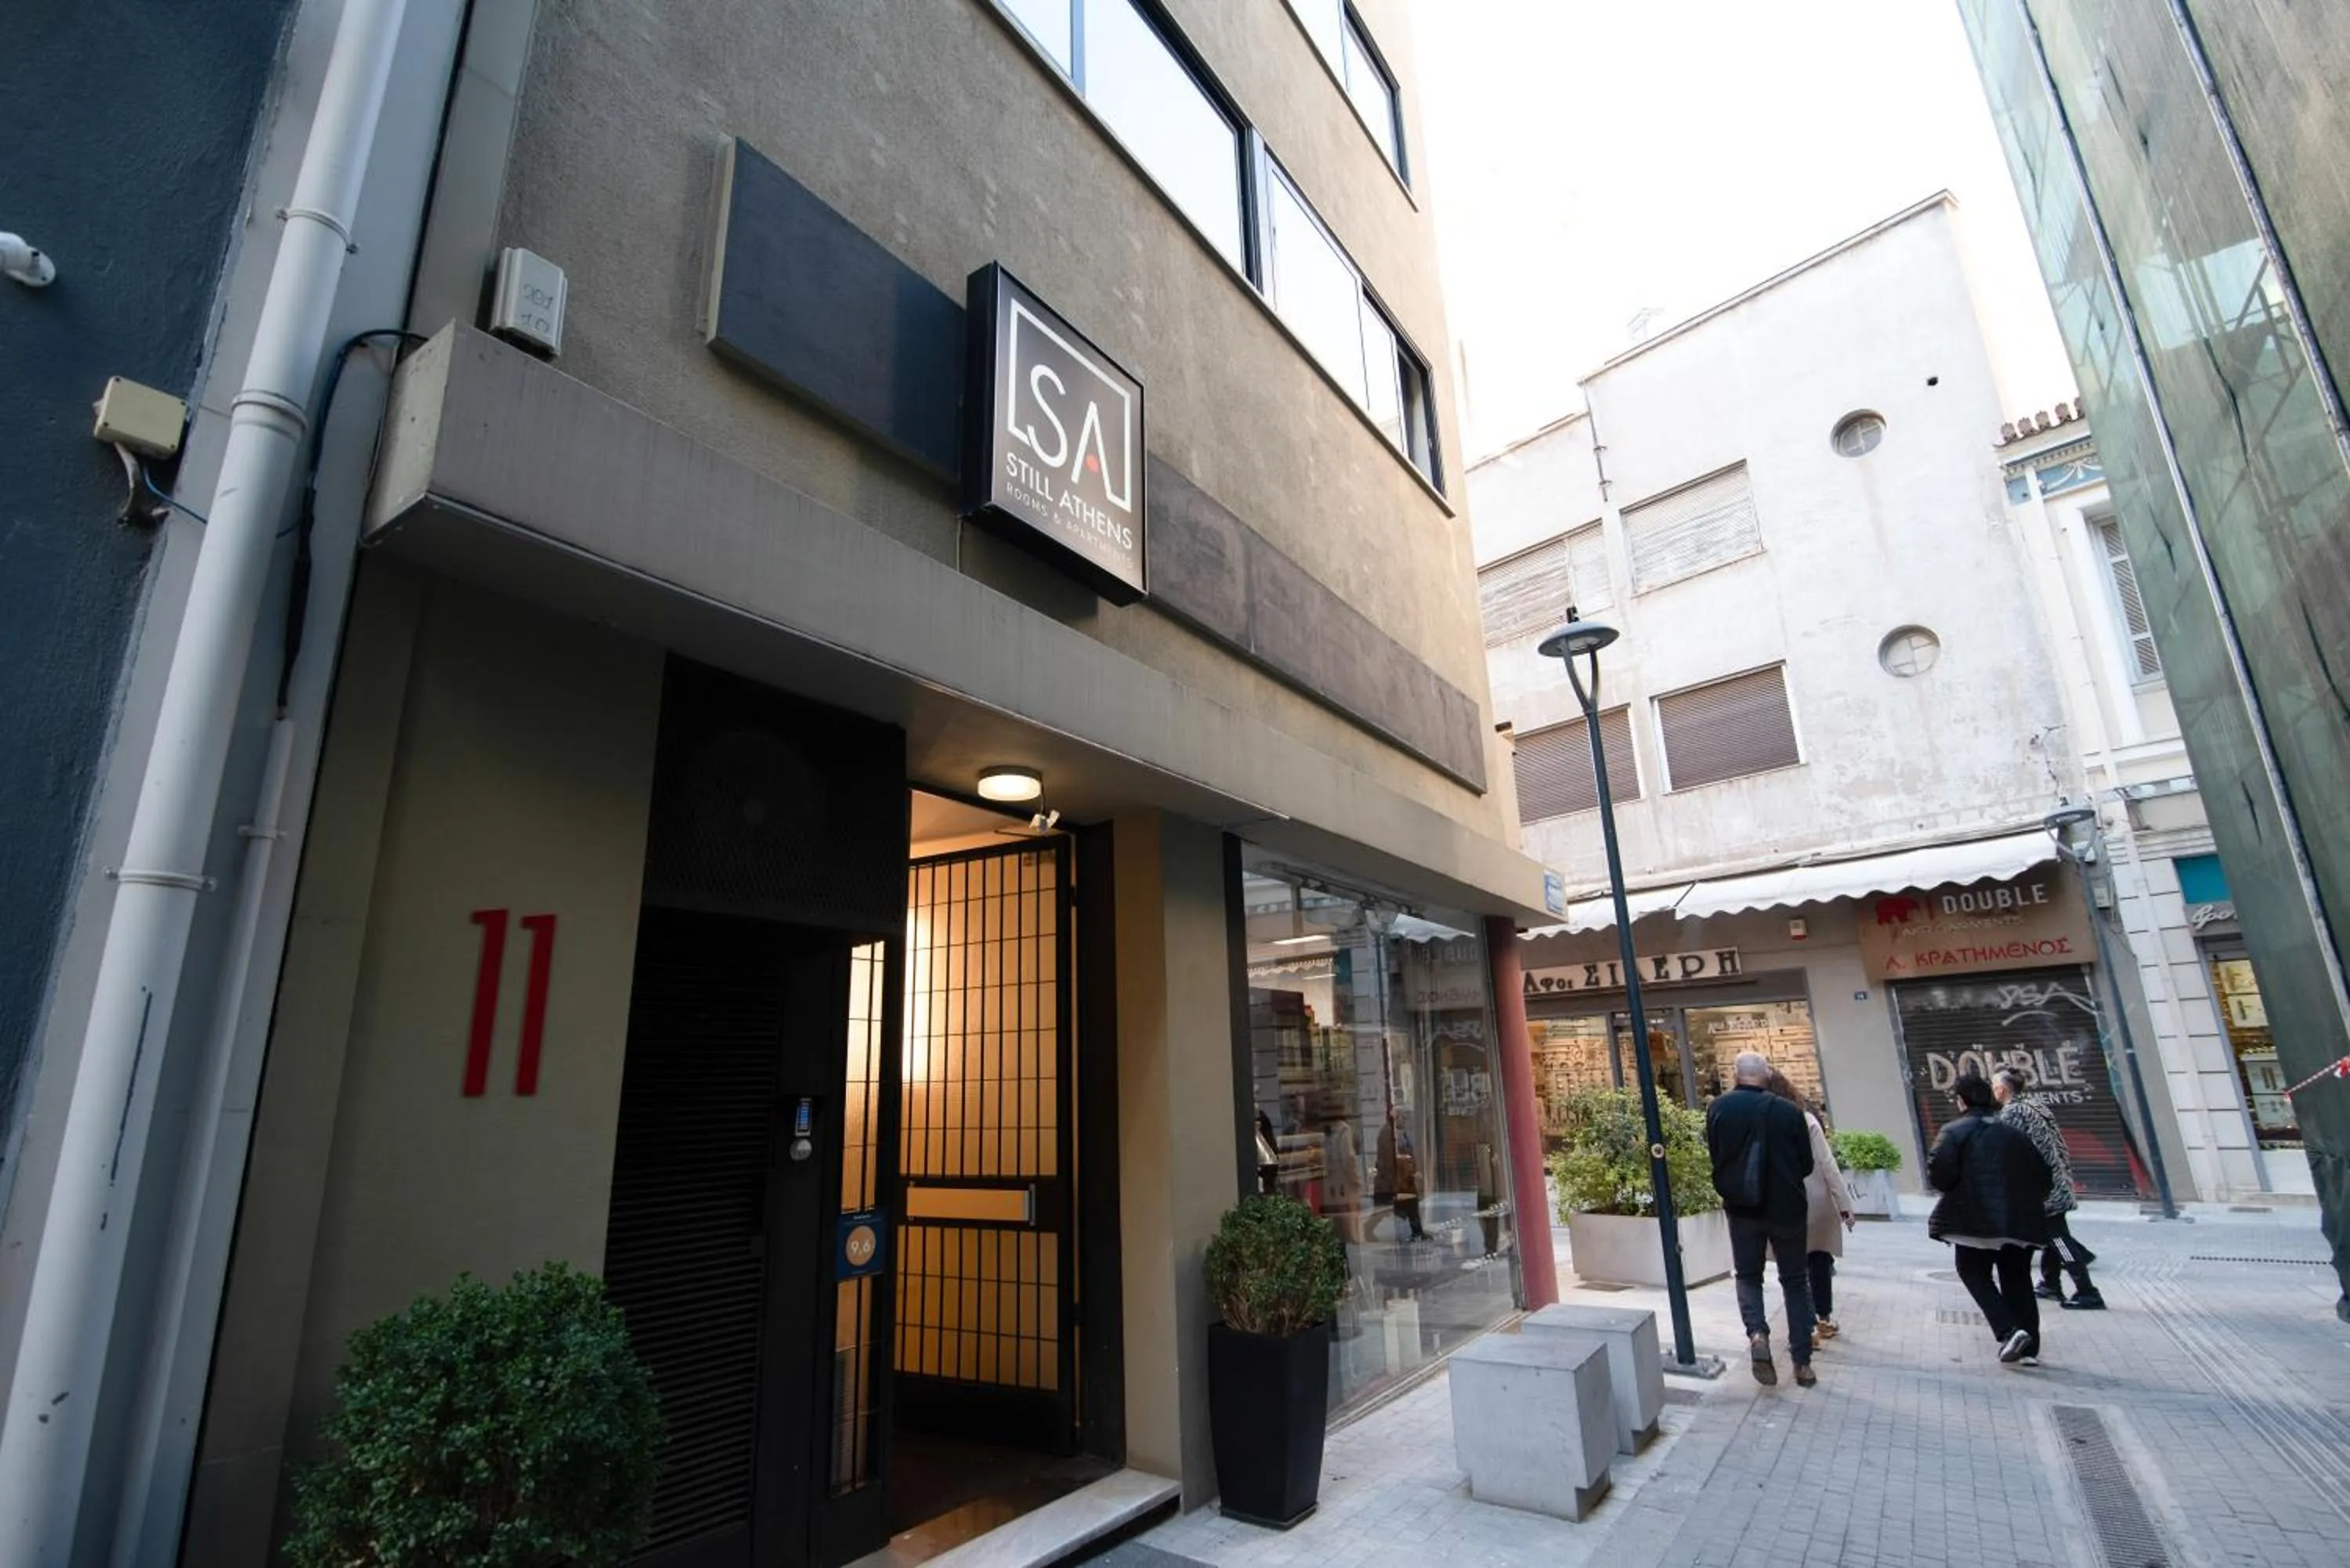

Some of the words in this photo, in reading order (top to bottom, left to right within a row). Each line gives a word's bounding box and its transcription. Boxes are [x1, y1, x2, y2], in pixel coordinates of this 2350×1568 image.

[1006, 481, 1049, 518] ROOMS
[1006, 451, 1054, 502] STILL
[1059, 490, 1133, 550] ATHENS
[1942, 883, 2049, 915] DOUBLE
[1583, 949, 1741, 988] ΣΙΕΡΗ
[461, 908, 557, 1098] 11
[1925, 1046, 2087, 1091] DOUBLE
